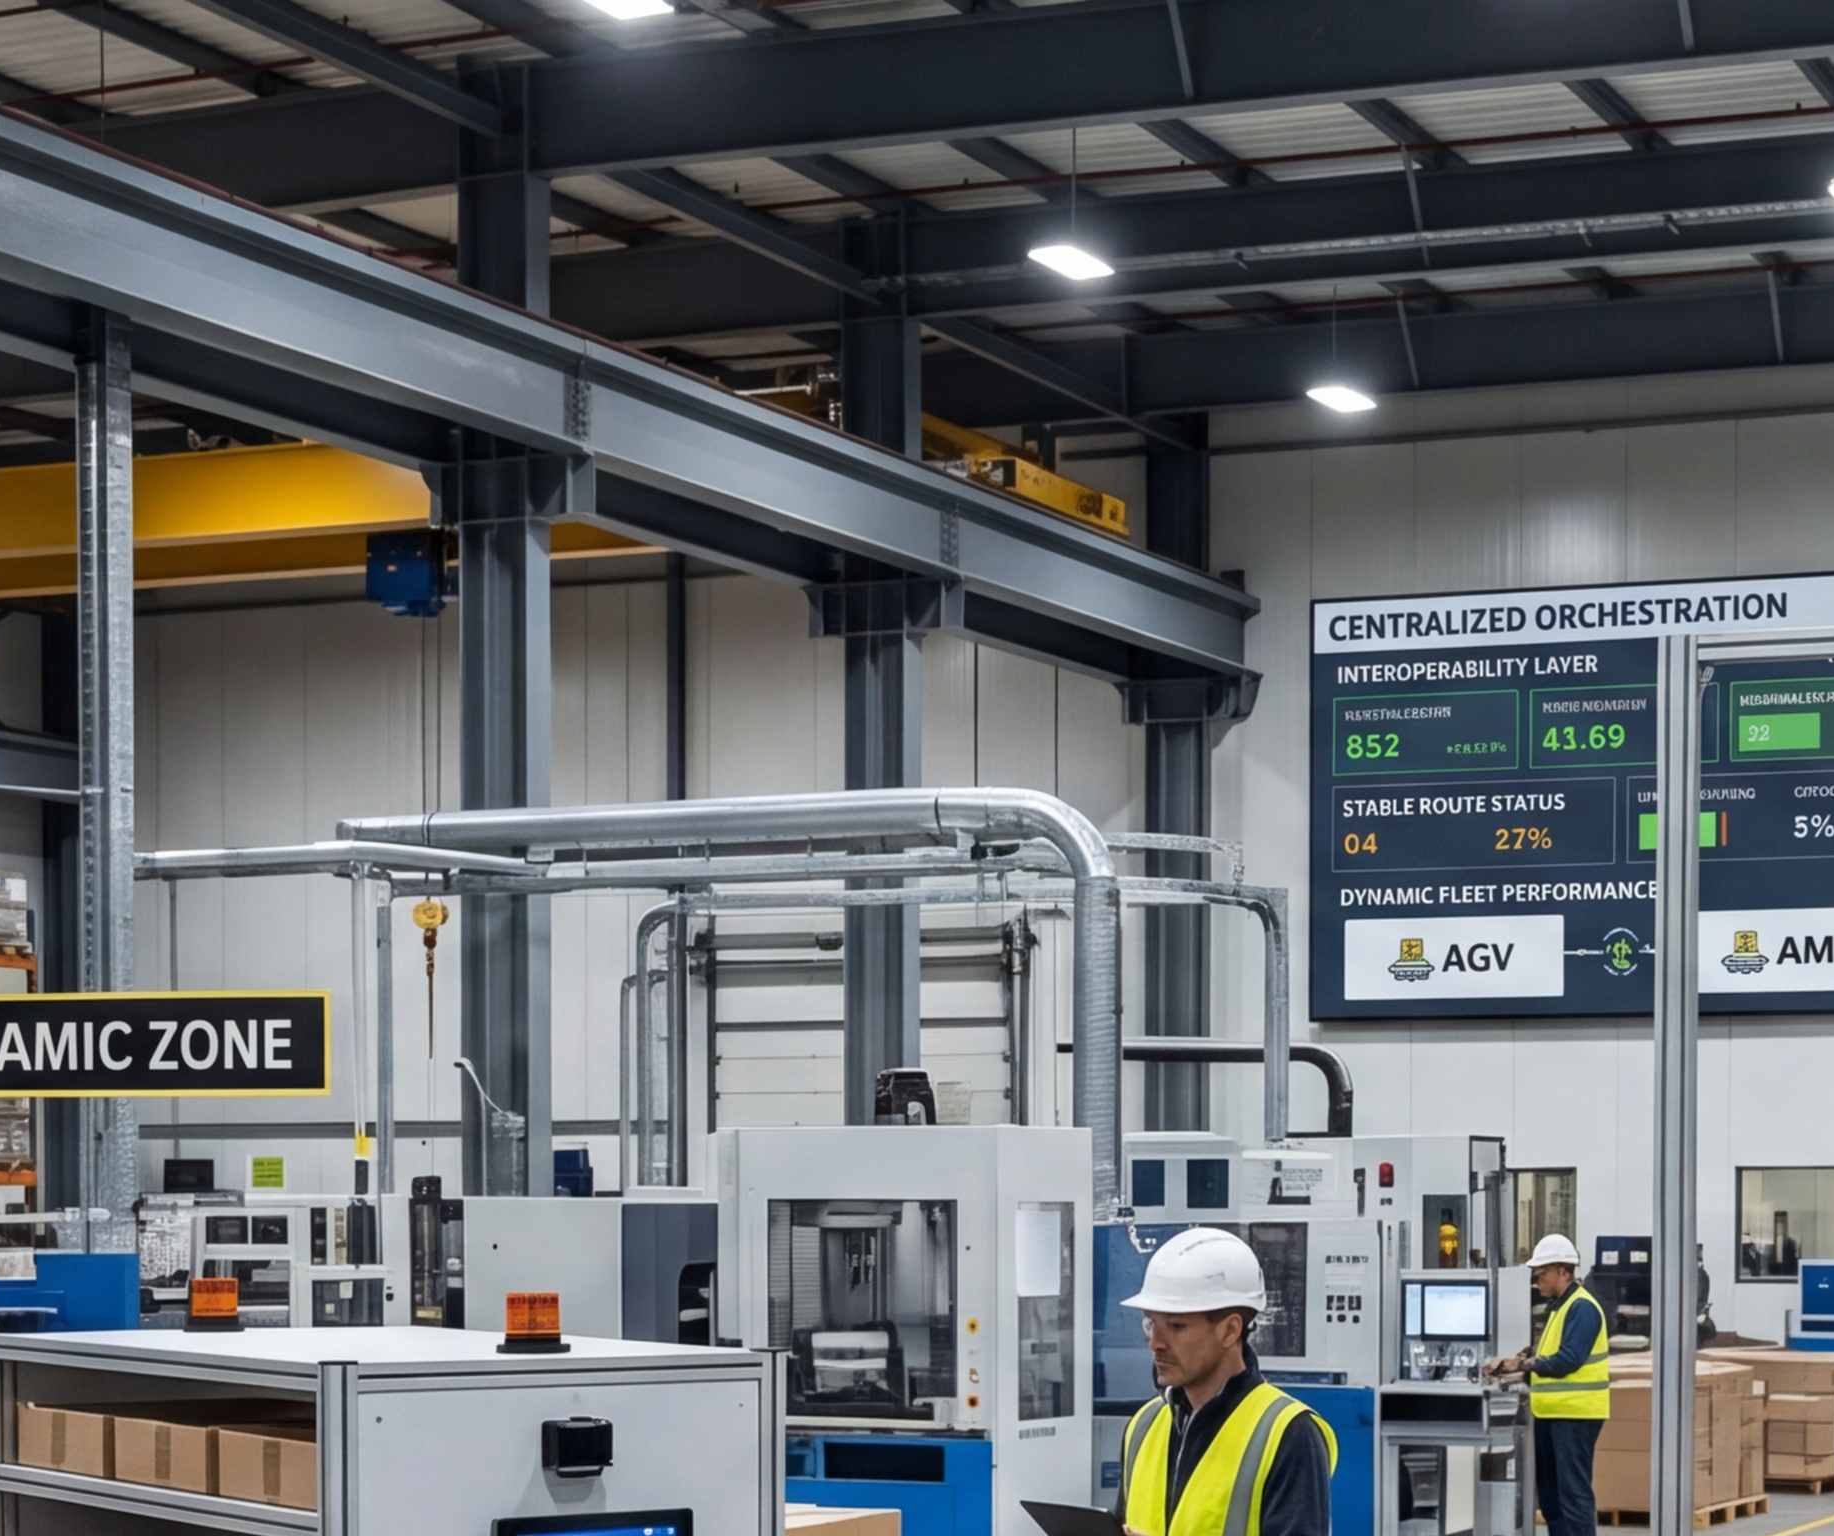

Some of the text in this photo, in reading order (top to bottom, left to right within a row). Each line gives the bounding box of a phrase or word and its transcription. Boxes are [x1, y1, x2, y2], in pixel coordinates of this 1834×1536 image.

[1328, 593, 1787, 641] CENTRALIZED ORCHESTRATION
[1337, 655, 1598, 683] INTEROPERABILITY LAYER
[1346, 734, 1400, 759] 852
[1343, 793, 1565, 817] STABLE ROUTE STATUS
[1494, 827, 1552, 850] 27%
[1793, 815, 1834, 838] 5%
[1344, 833, 1378, 855] 04
[1340, 885, 1433, 906] DYNAMIC
[1439, 884, 1496, 903] FLEET
[1442, 944, 1514, 972] AGV
[149, 1019, 293, 1071] ZONE
